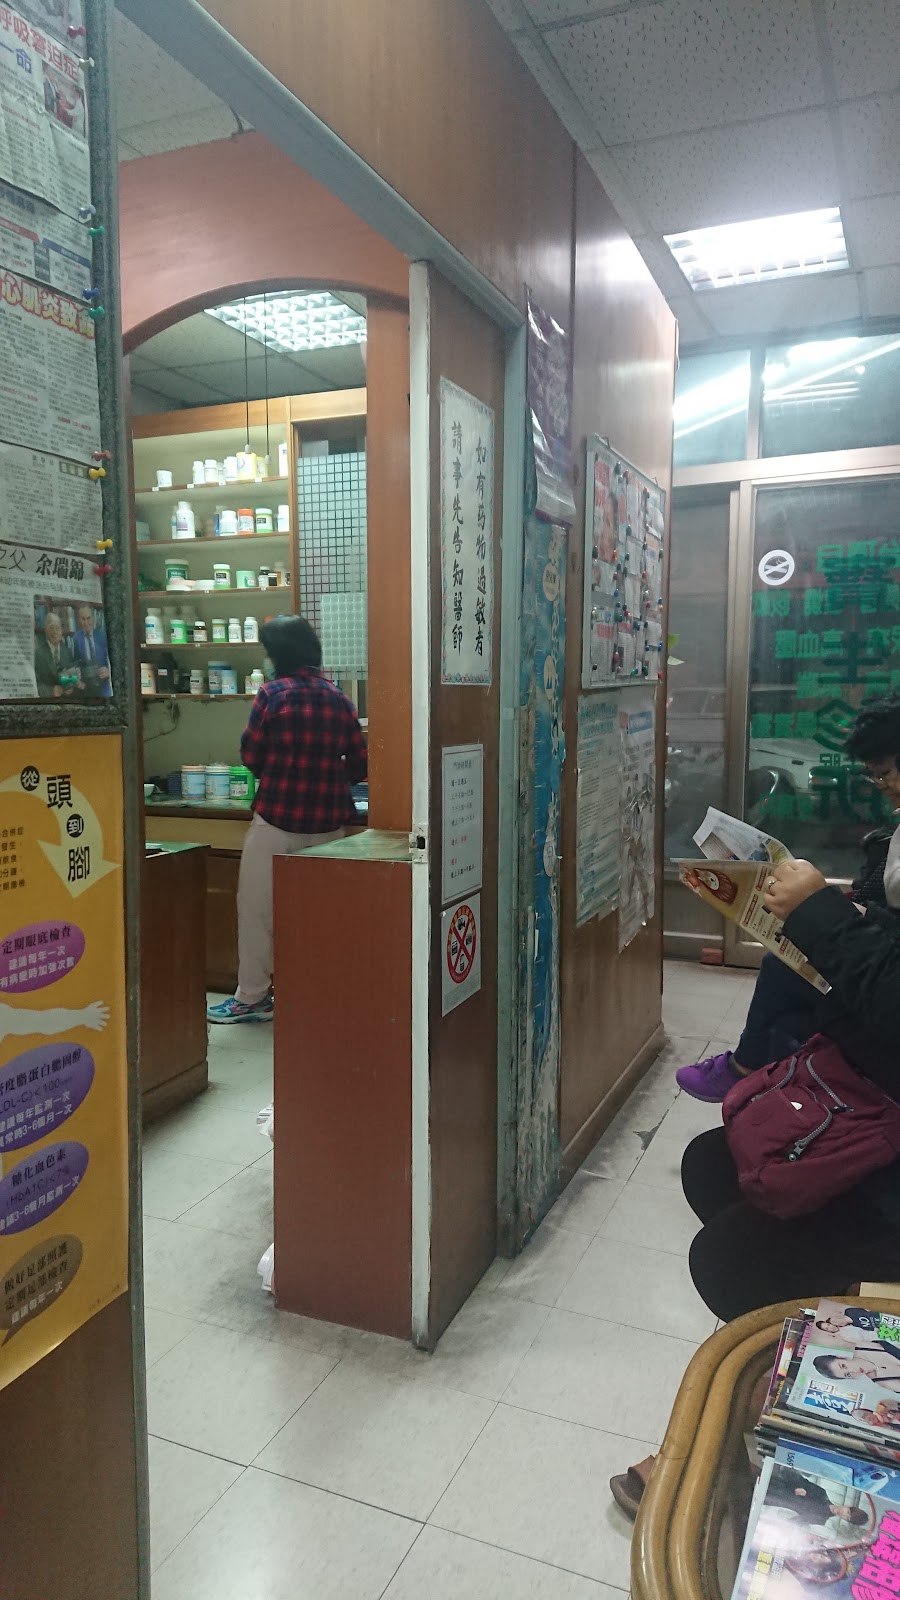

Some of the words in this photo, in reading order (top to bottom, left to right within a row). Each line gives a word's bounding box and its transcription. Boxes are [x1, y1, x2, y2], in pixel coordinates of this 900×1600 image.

[451, 420, 464, 656] 請事先告知醫師
[2, 925, 71, 955] 定期眼底檢查
[8, 946, 66, 971] 建議每年一次
[12, 1148, 66, 1188] 糖化血色素
